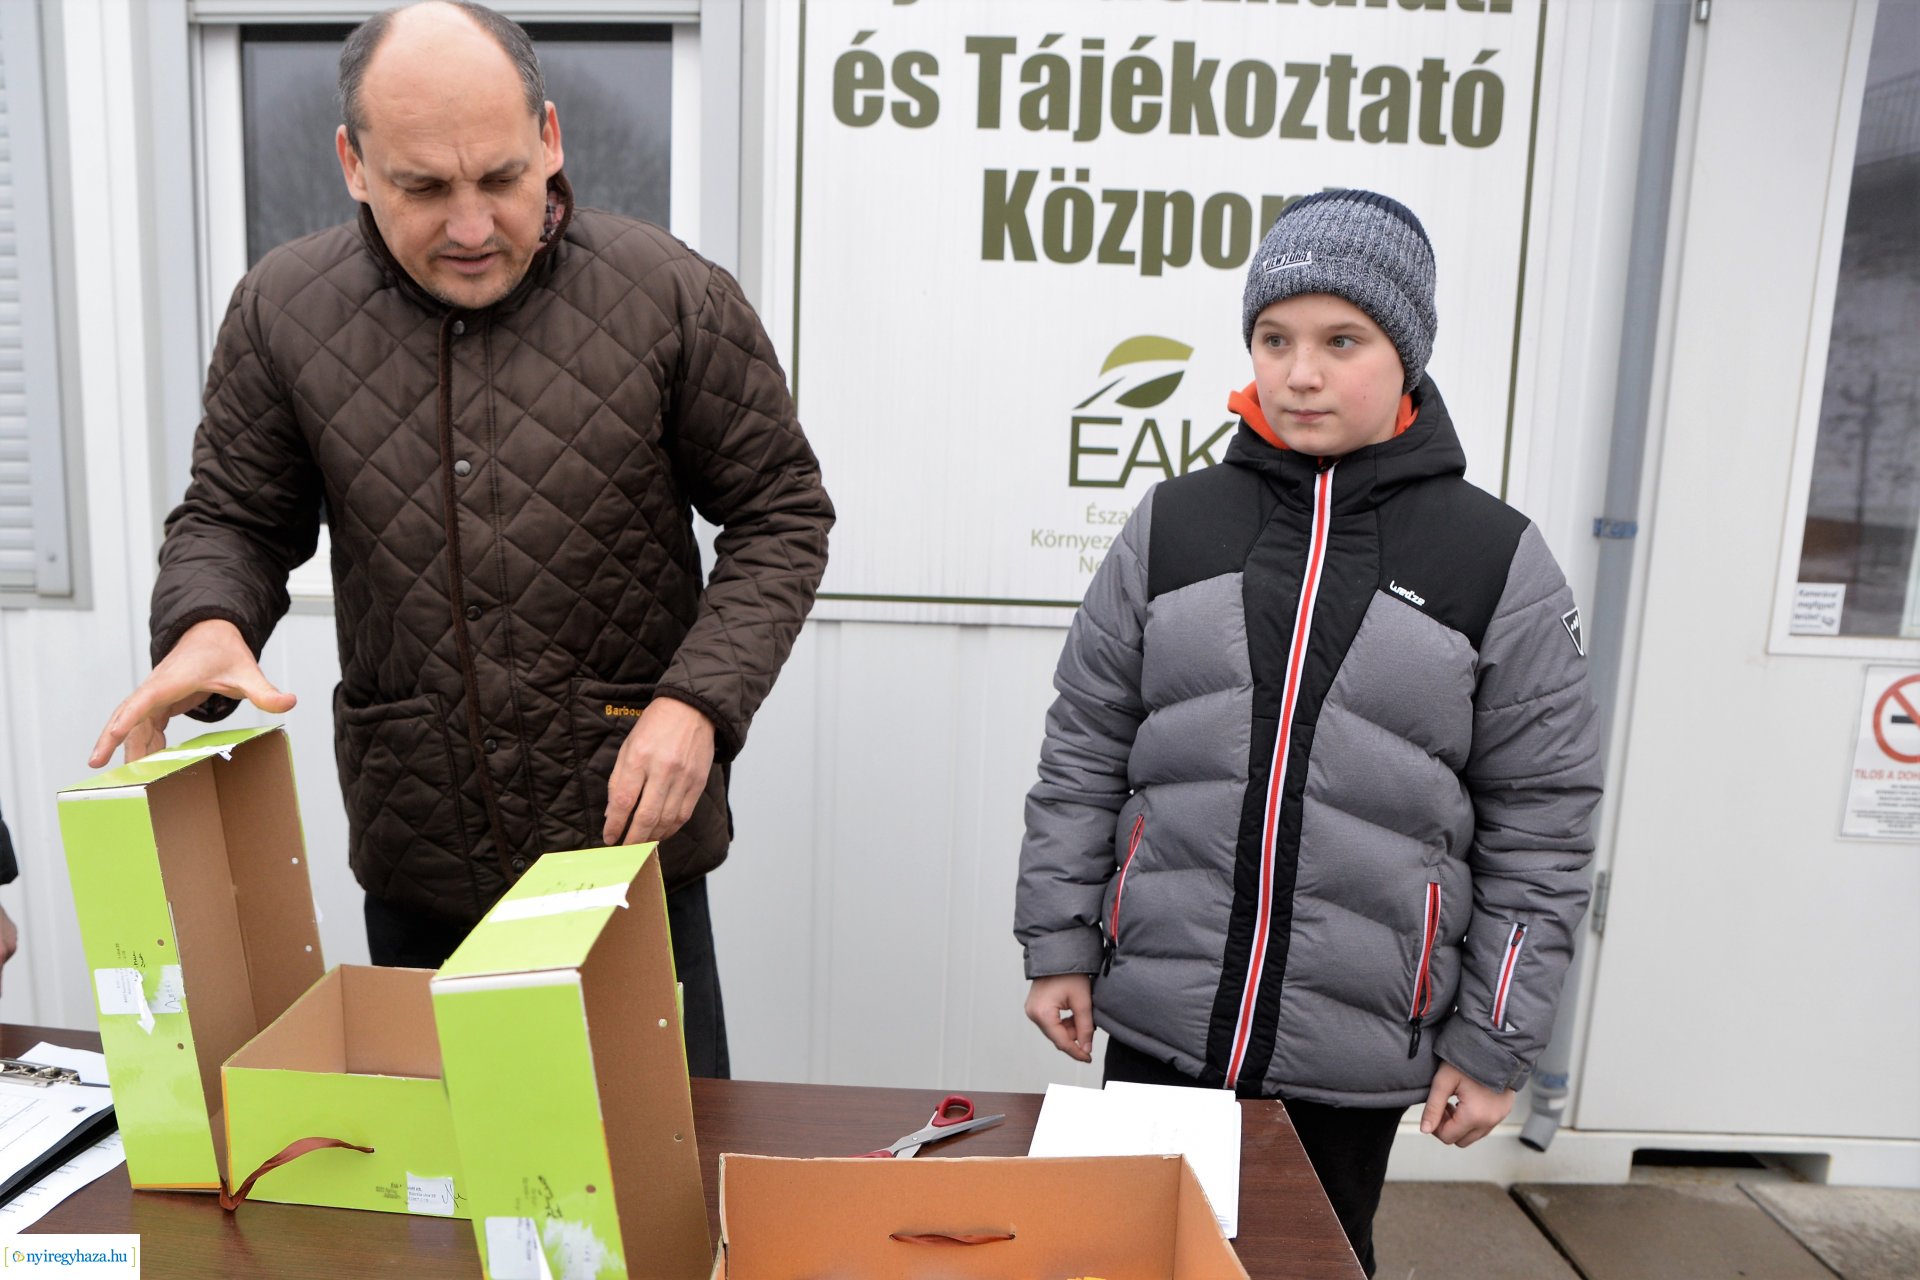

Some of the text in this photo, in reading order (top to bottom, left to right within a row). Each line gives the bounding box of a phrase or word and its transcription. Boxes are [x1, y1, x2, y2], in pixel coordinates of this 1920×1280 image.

[831, 29, 1505, 149] és Tájékoztató
[981, 167, 1345, 277] Közpo
[1086, 501, 1135, 526] Észa
[1887, 770, 1895, 780] A
